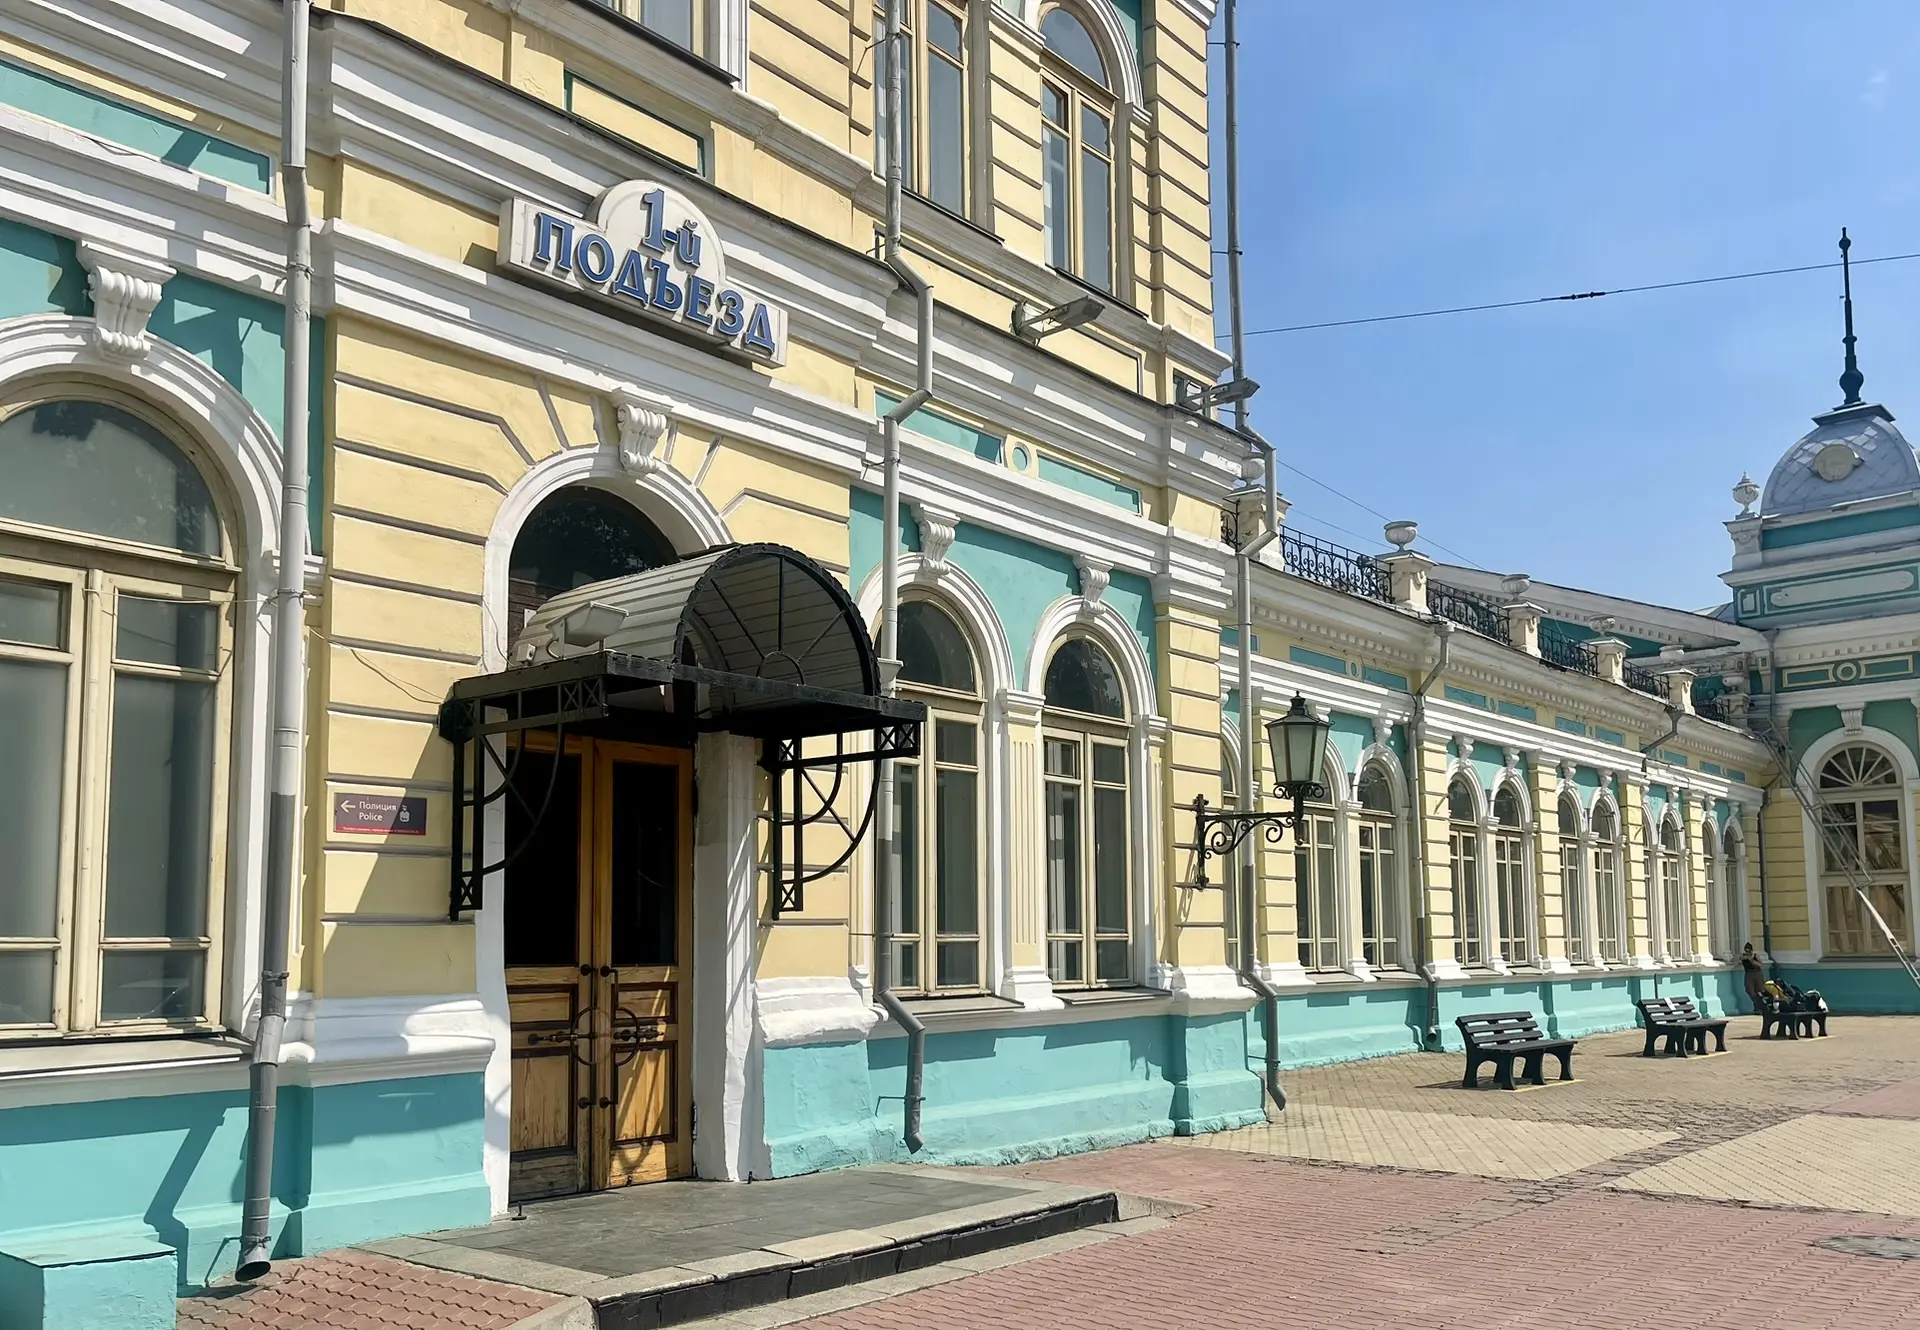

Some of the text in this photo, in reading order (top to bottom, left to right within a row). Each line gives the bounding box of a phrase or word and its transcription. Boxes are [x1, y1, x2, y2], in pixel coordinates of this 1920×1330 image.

[643, 188, 702, 266] 1-й
[537, 212, 776, 352] ПОДЪЕЗД
[359, 801, 397, 811] Полиция
[359, 812, 383, 821] Police
